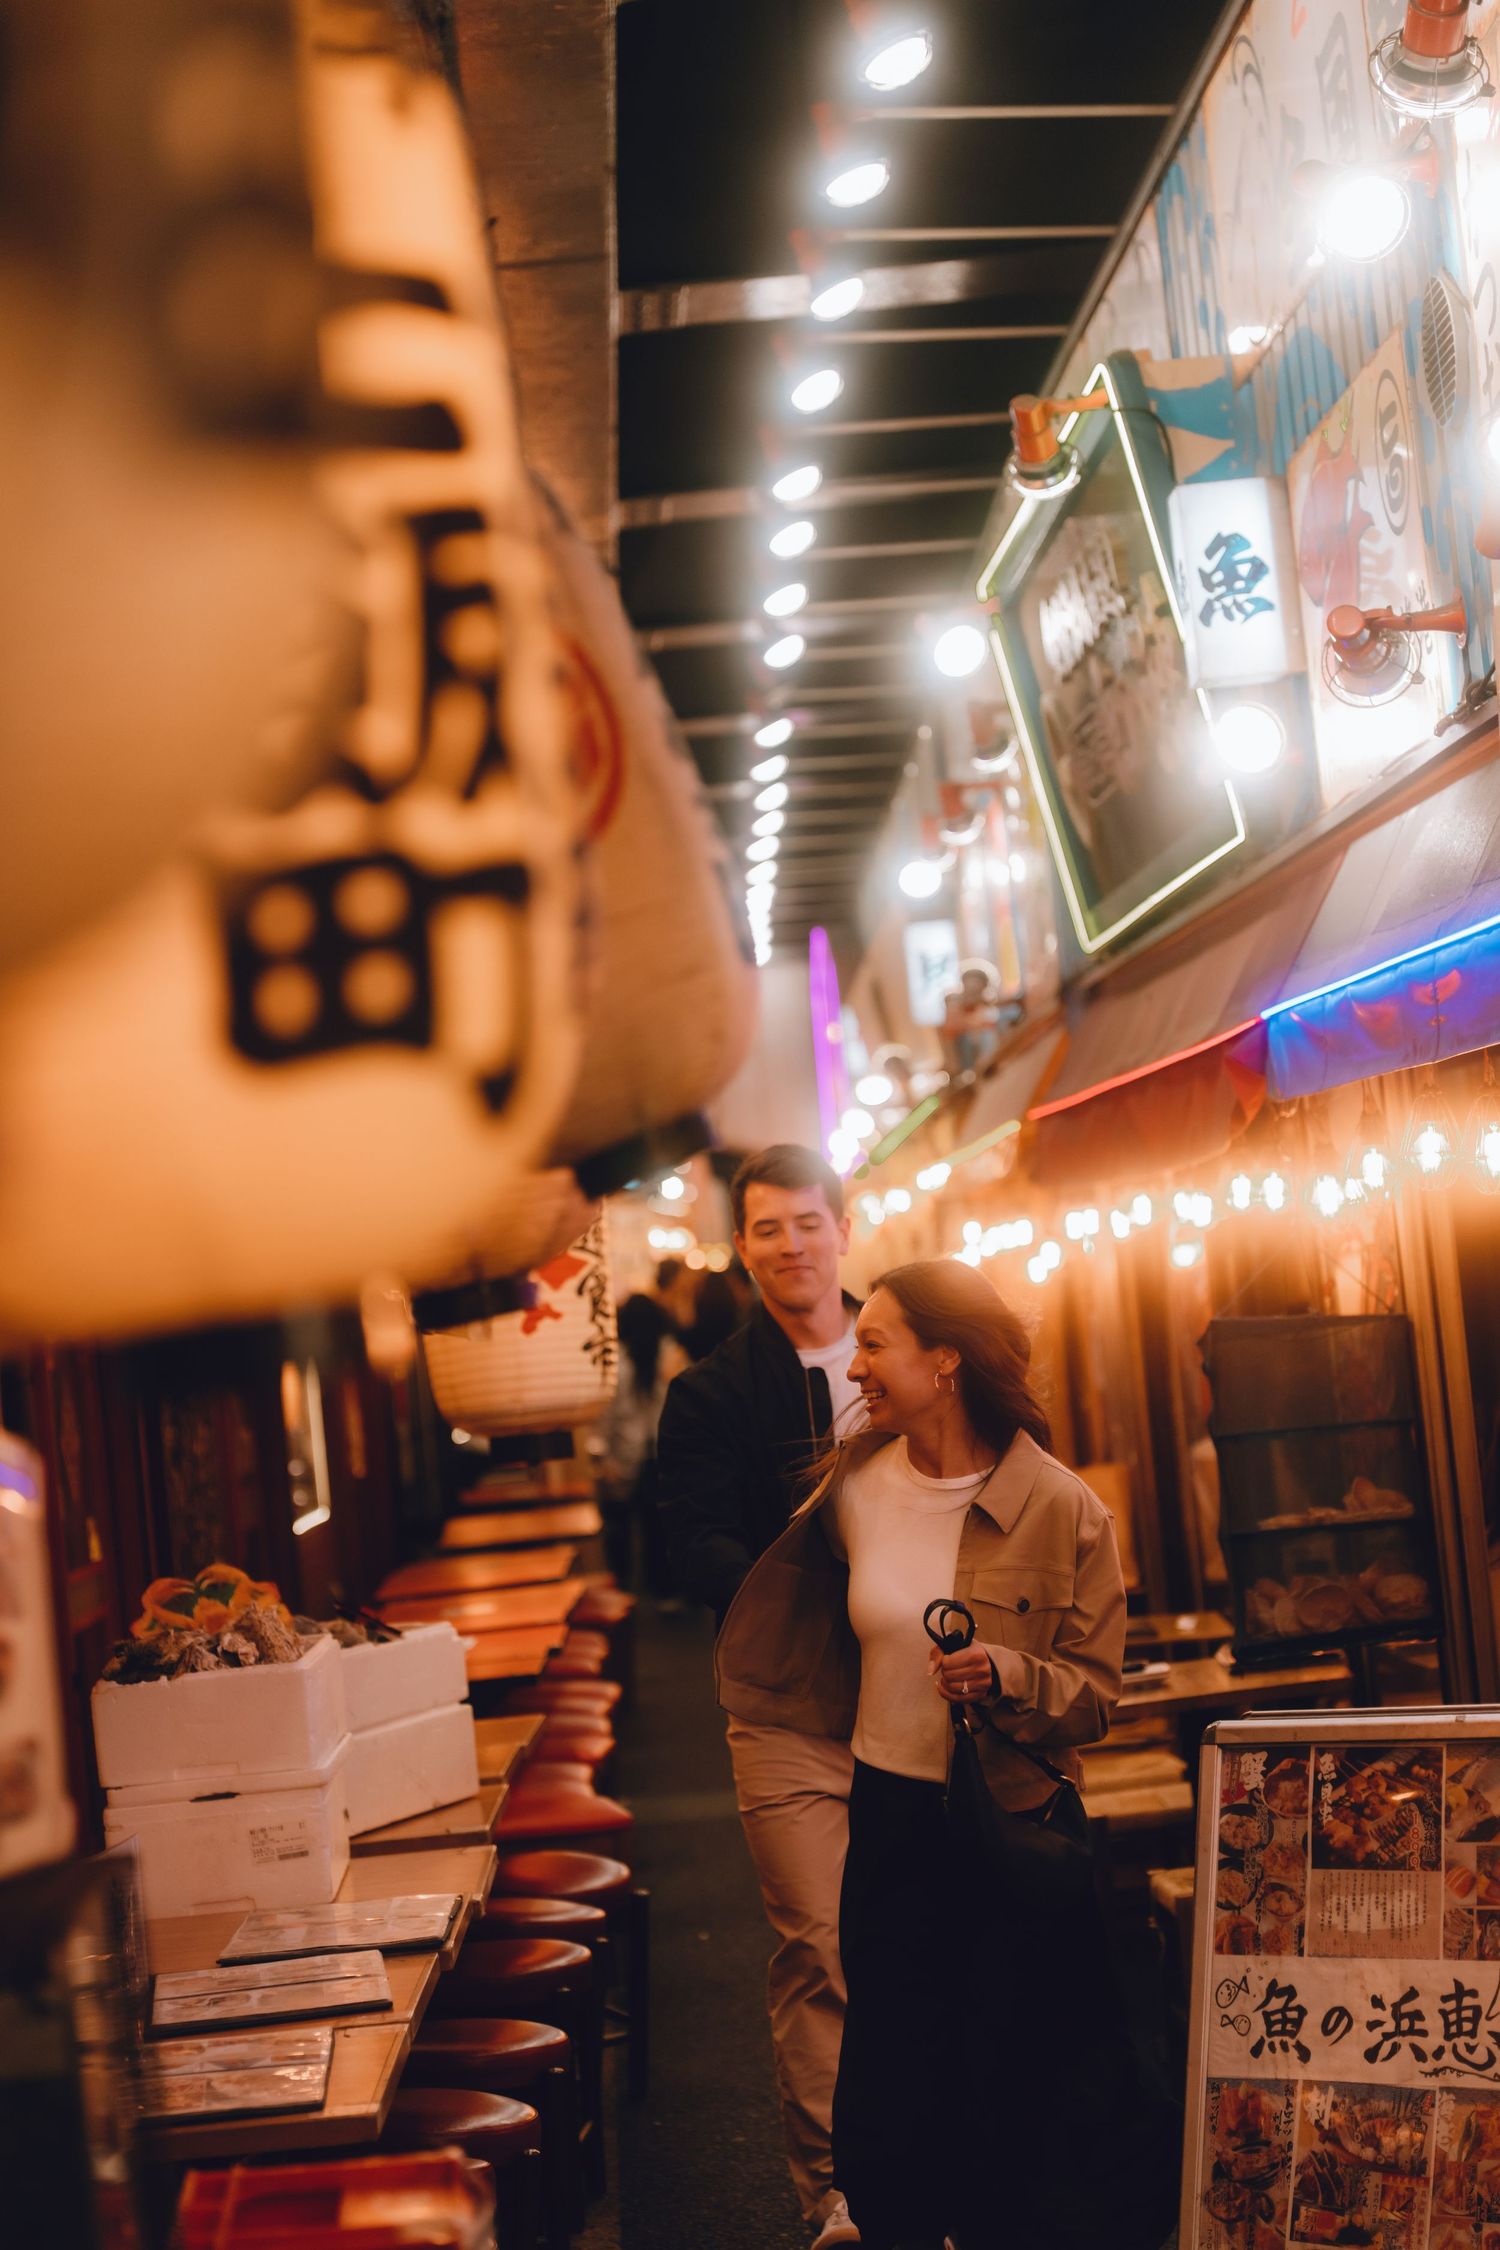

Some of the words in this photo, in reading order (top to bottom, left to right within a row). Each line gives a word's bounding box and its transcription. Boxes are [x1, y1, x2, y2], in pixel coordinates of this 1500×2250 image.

[1198, 531, 1276, 628] 魚
[1250, 1978, 1500, 2071] 魚の浜恵
